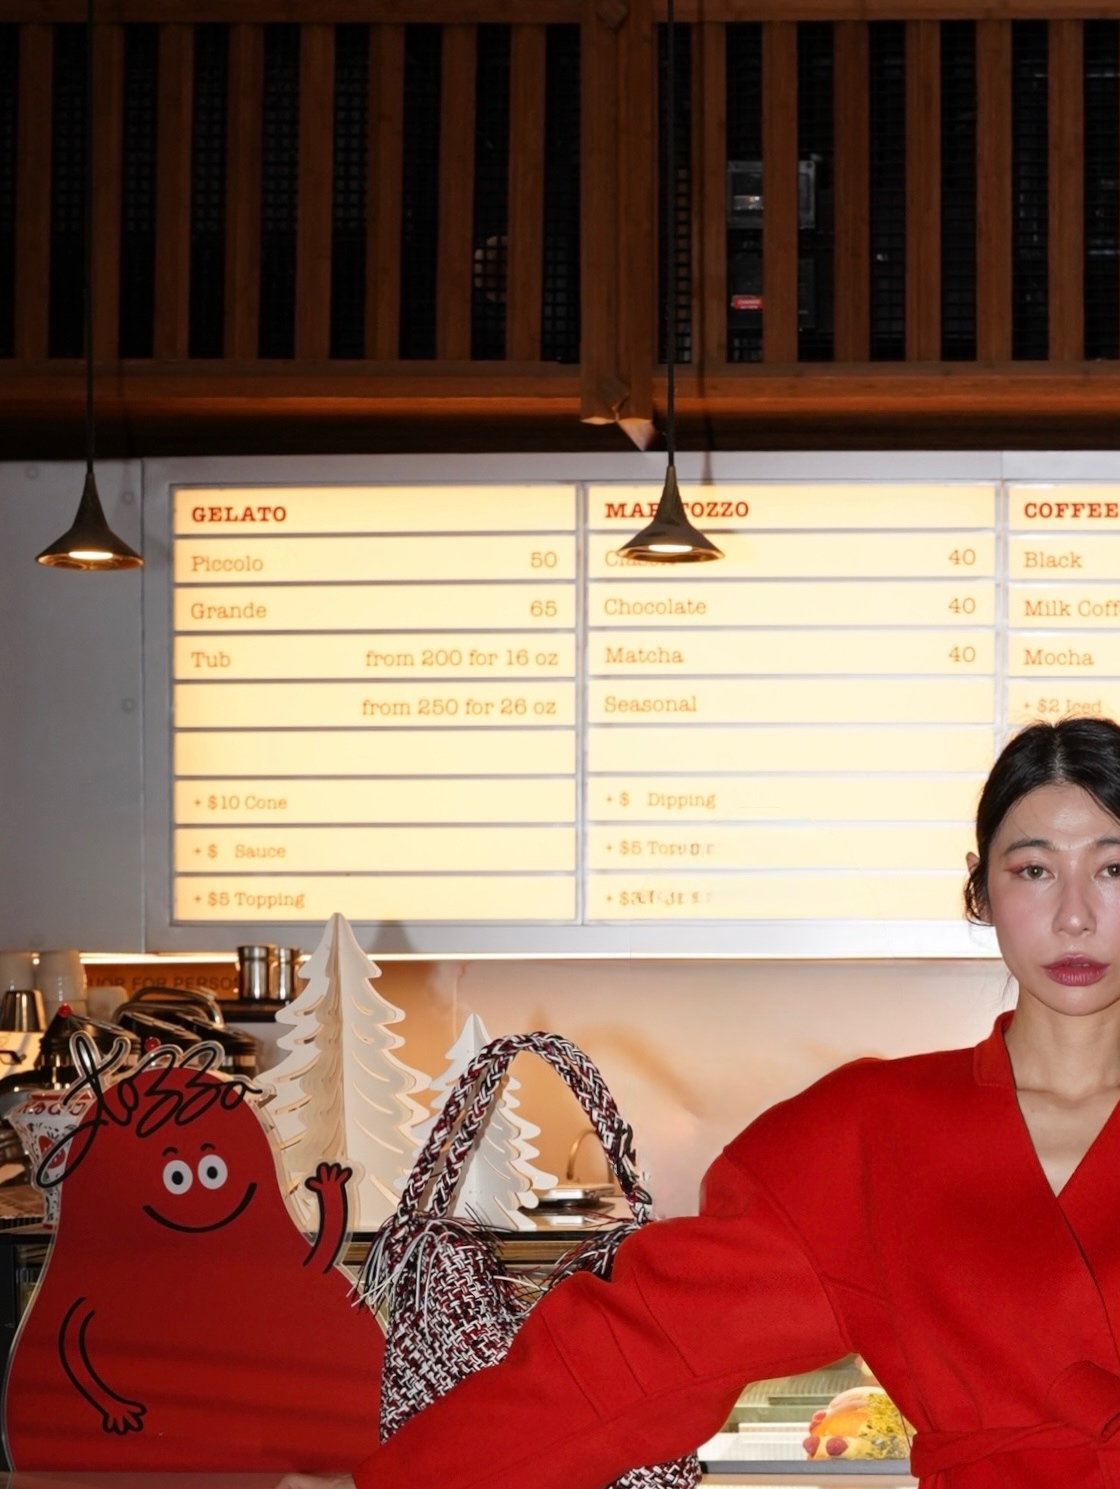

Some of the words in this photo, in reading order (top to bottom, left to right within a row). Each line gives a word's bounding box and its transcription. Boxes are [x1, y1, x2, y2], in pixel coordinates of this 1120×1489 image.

[192, 506, 286, 523] GELATO
[605, 502, 749, 519] MAOZZO
[1024, 502, 1119, 519] COFFEE
[191, 555, 264, 575] Piccolo
[530, 551, 558, 568] 50
[948, 548, 976, 566] 40
[1024, 551, 1082, 568] Black
[190, 602, 267, 619] Grande
[530, 600, 557, 617] 65
[603, 597, 707, 616] Chocolate
[948, 597, 976, 614] 40
[1024, 600, 1071, 617] Milk
[190, 650, 231, 668] Tub
[365, 650, 415, 667] from
[421, 649, 462, 667] 200
[468, 649, 498, 666] for
[507, 649, 530, 666] 16
[535, 652, 558, 666] oz
[605, 646, 684, 664] Matcha
[948, 646, 976, 663] 40
[1023, 648, 1094, 666] Mocha
[361, 699, 411, 716] from
[417, 698, 459, 715] 250
[465, 698, 495, 715] for
[500, 698, 527, 715] 26
[533, 701, 556, 715] oz
[604, 695, 697, 713] Seasonal
[1037, 698, 1059, 715] $2
[1065, 699, 1102, 714] Iced
[207, 794, 240, 811] $10
[244, 795, 288, 810] Cone
[647, 792, 716, 810] Dipping
[234, 843, 286, 859] Sauce
[619, 839, 642, 856] $5
[207, 891, 230, 907] $5
[234, 891, 305, 910] Topping
